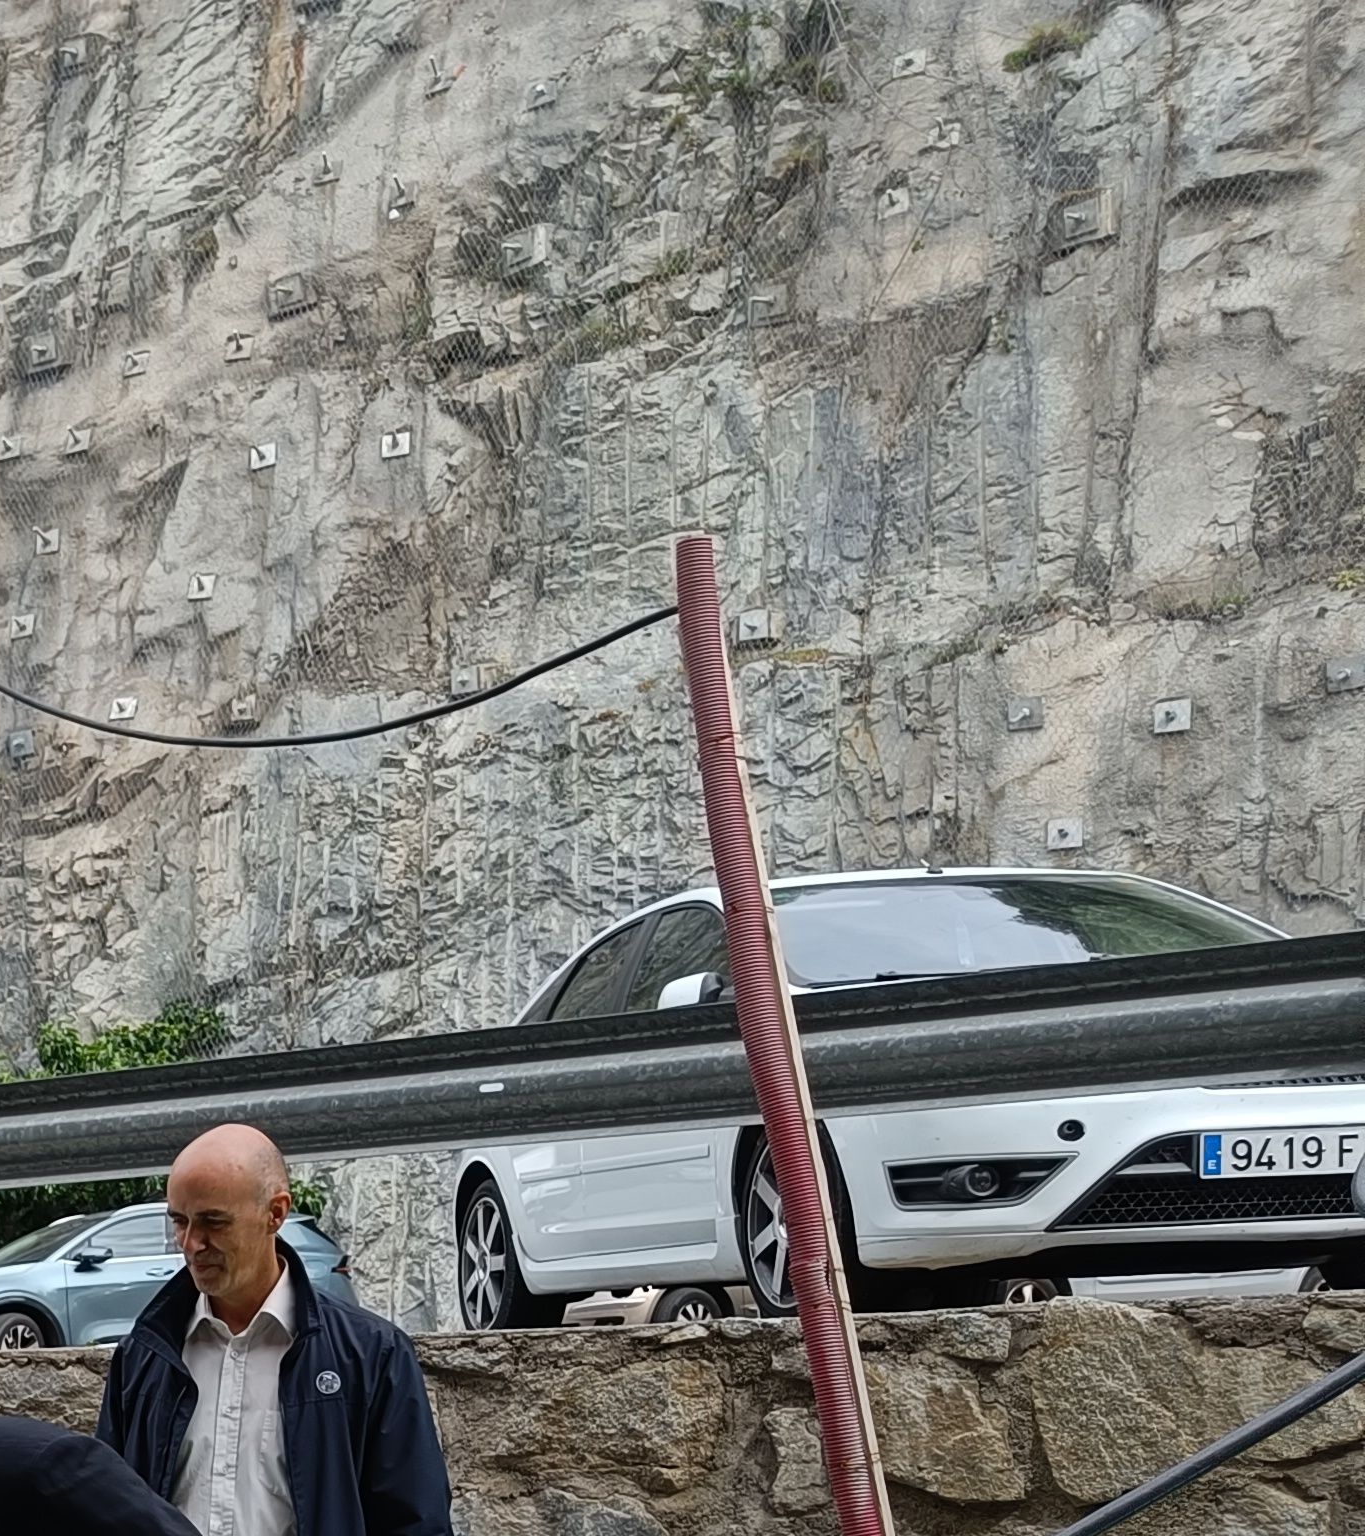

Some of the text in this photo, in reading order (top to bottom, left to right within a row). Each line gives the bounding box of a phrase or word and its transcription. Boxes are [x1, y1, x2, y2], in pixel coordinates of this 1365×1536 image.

[1207, 1159, 1217, 1170] E
[1231, 1134, 1359, 1171] 9419 F
